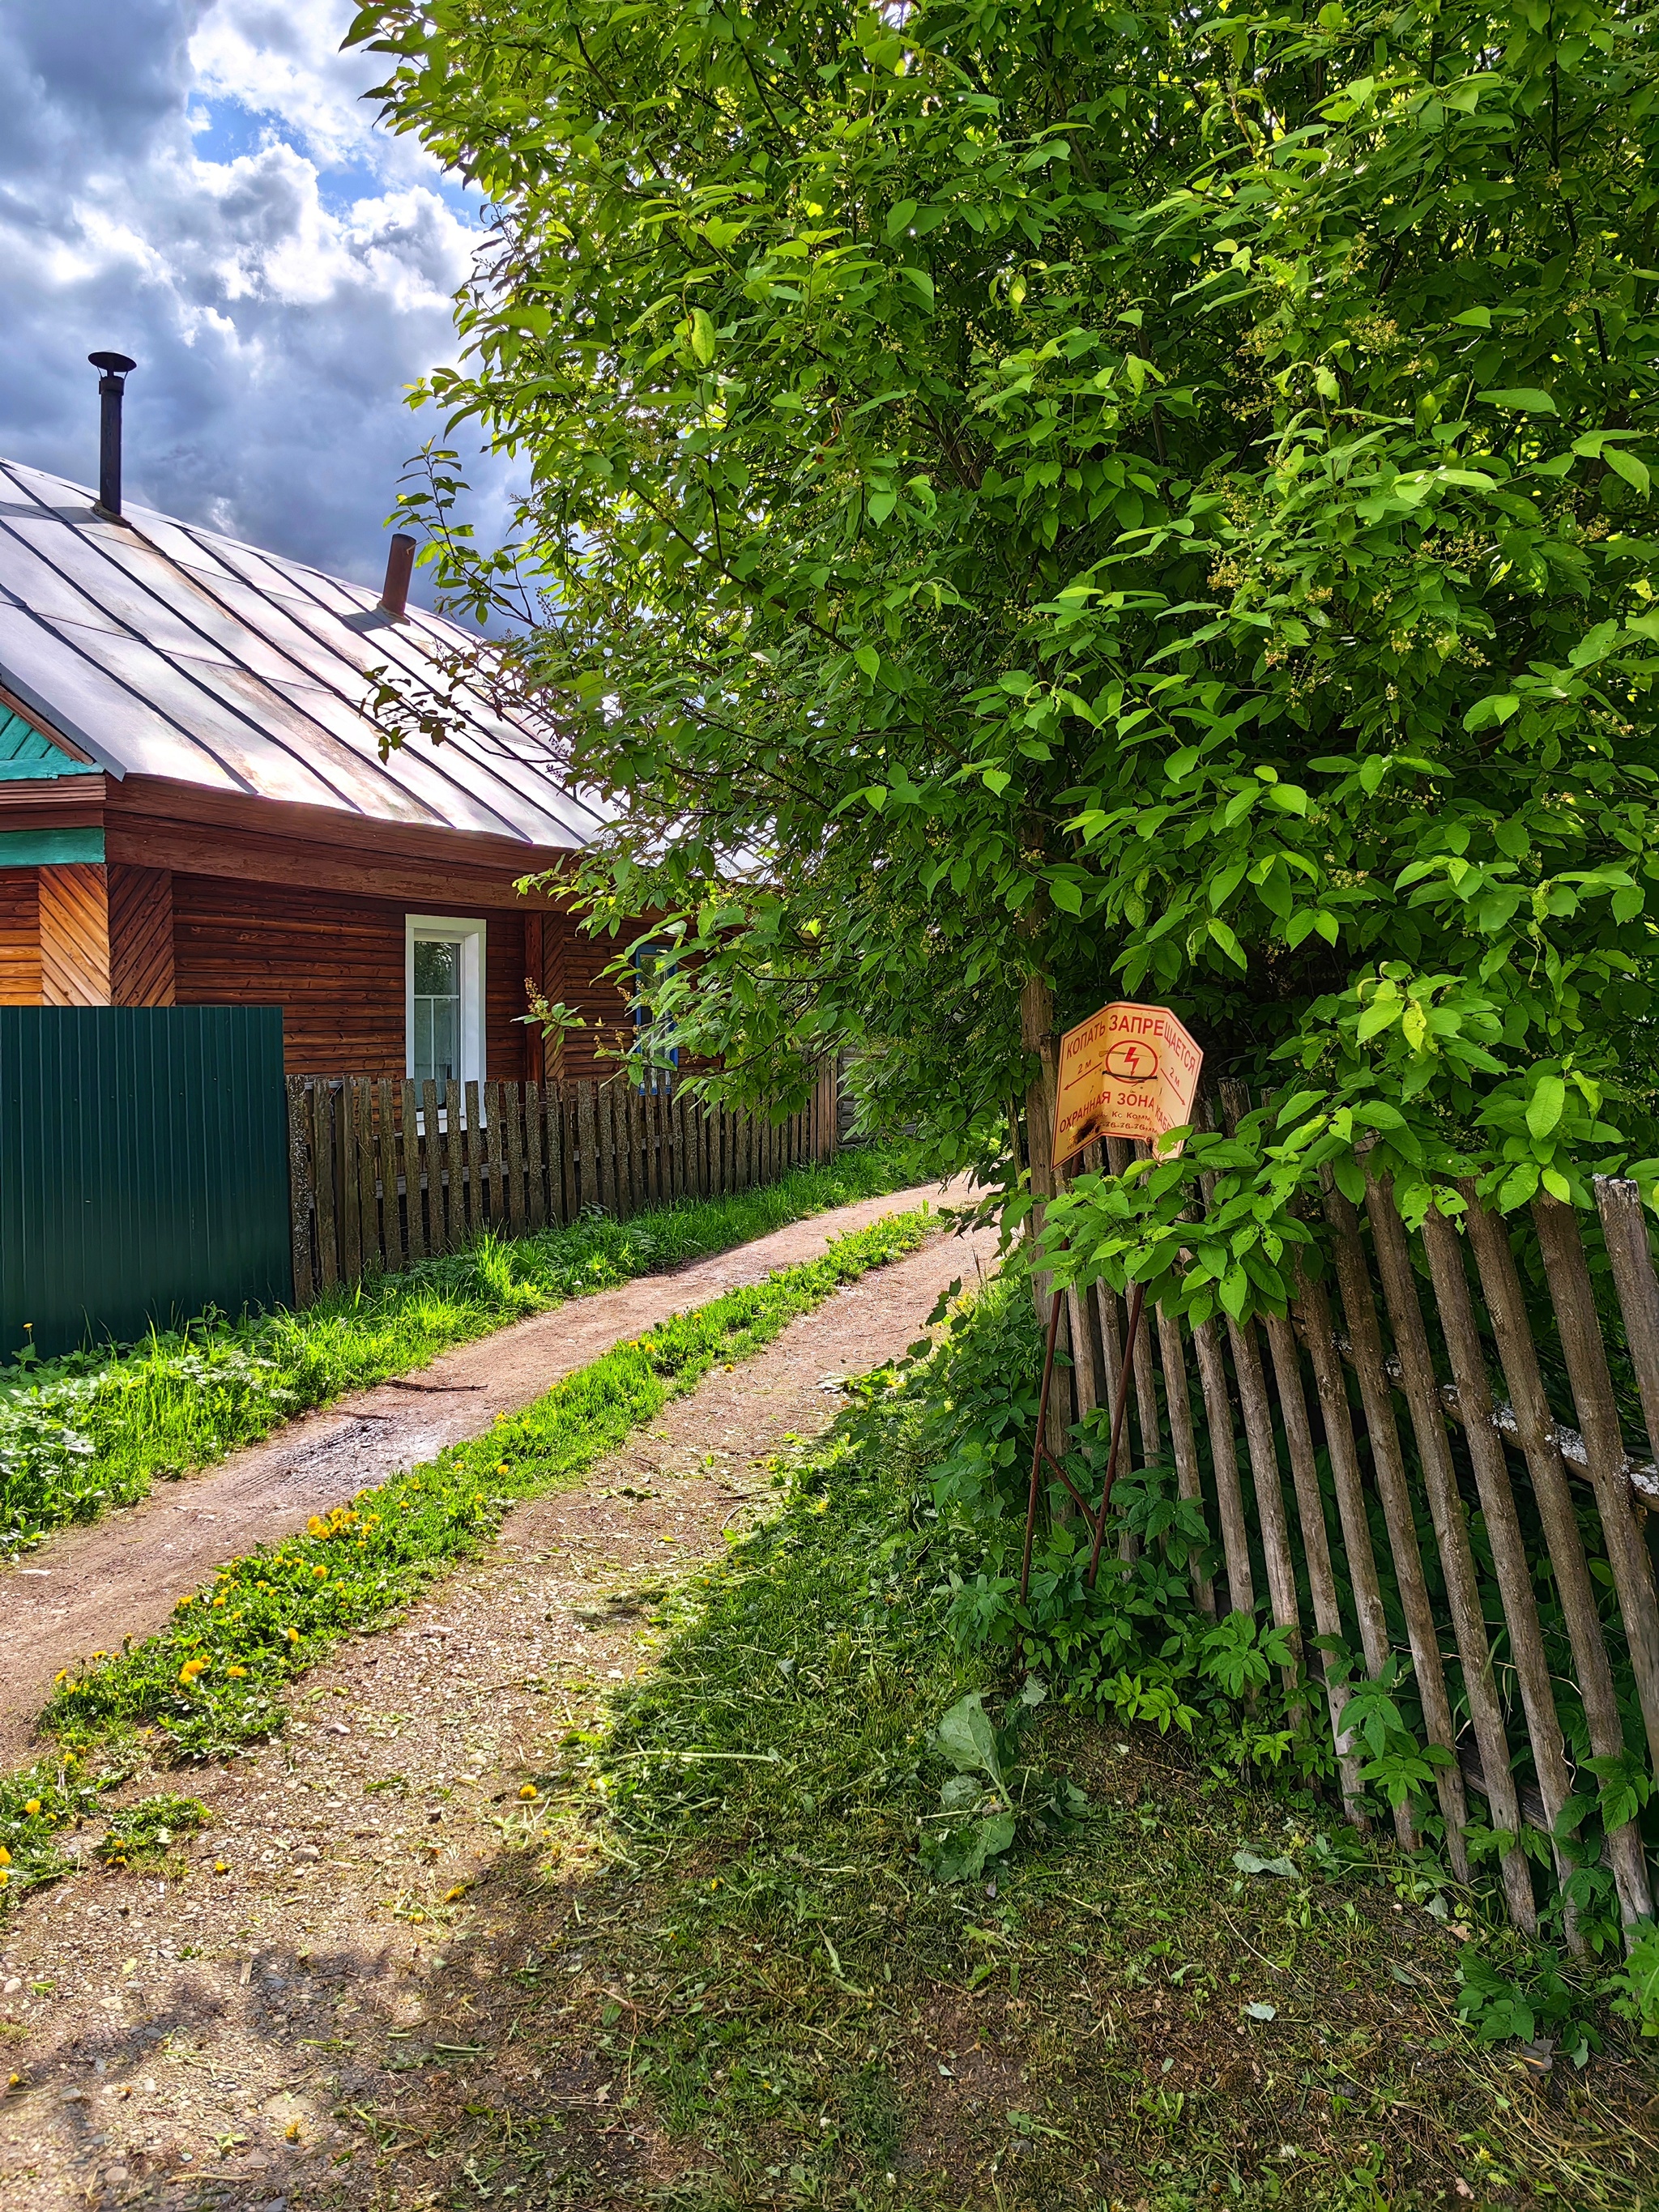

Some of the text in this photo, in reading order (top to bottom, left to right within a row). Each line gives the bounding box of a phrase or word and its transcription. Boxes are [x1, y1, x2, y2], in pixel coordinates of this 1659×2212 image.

[1065, 1014, 1196, 1076] КОПАТЬ ЗАПРЕЩАЕТСЯ
[1077, 1064, 1083, 1074] 2
[1169, 1067, 1175, 1078] 2
[1059, 1091, 1111, 1134] ОХРАННАЯ
[1116, 1092, 1155, 1111] ЗОНА
